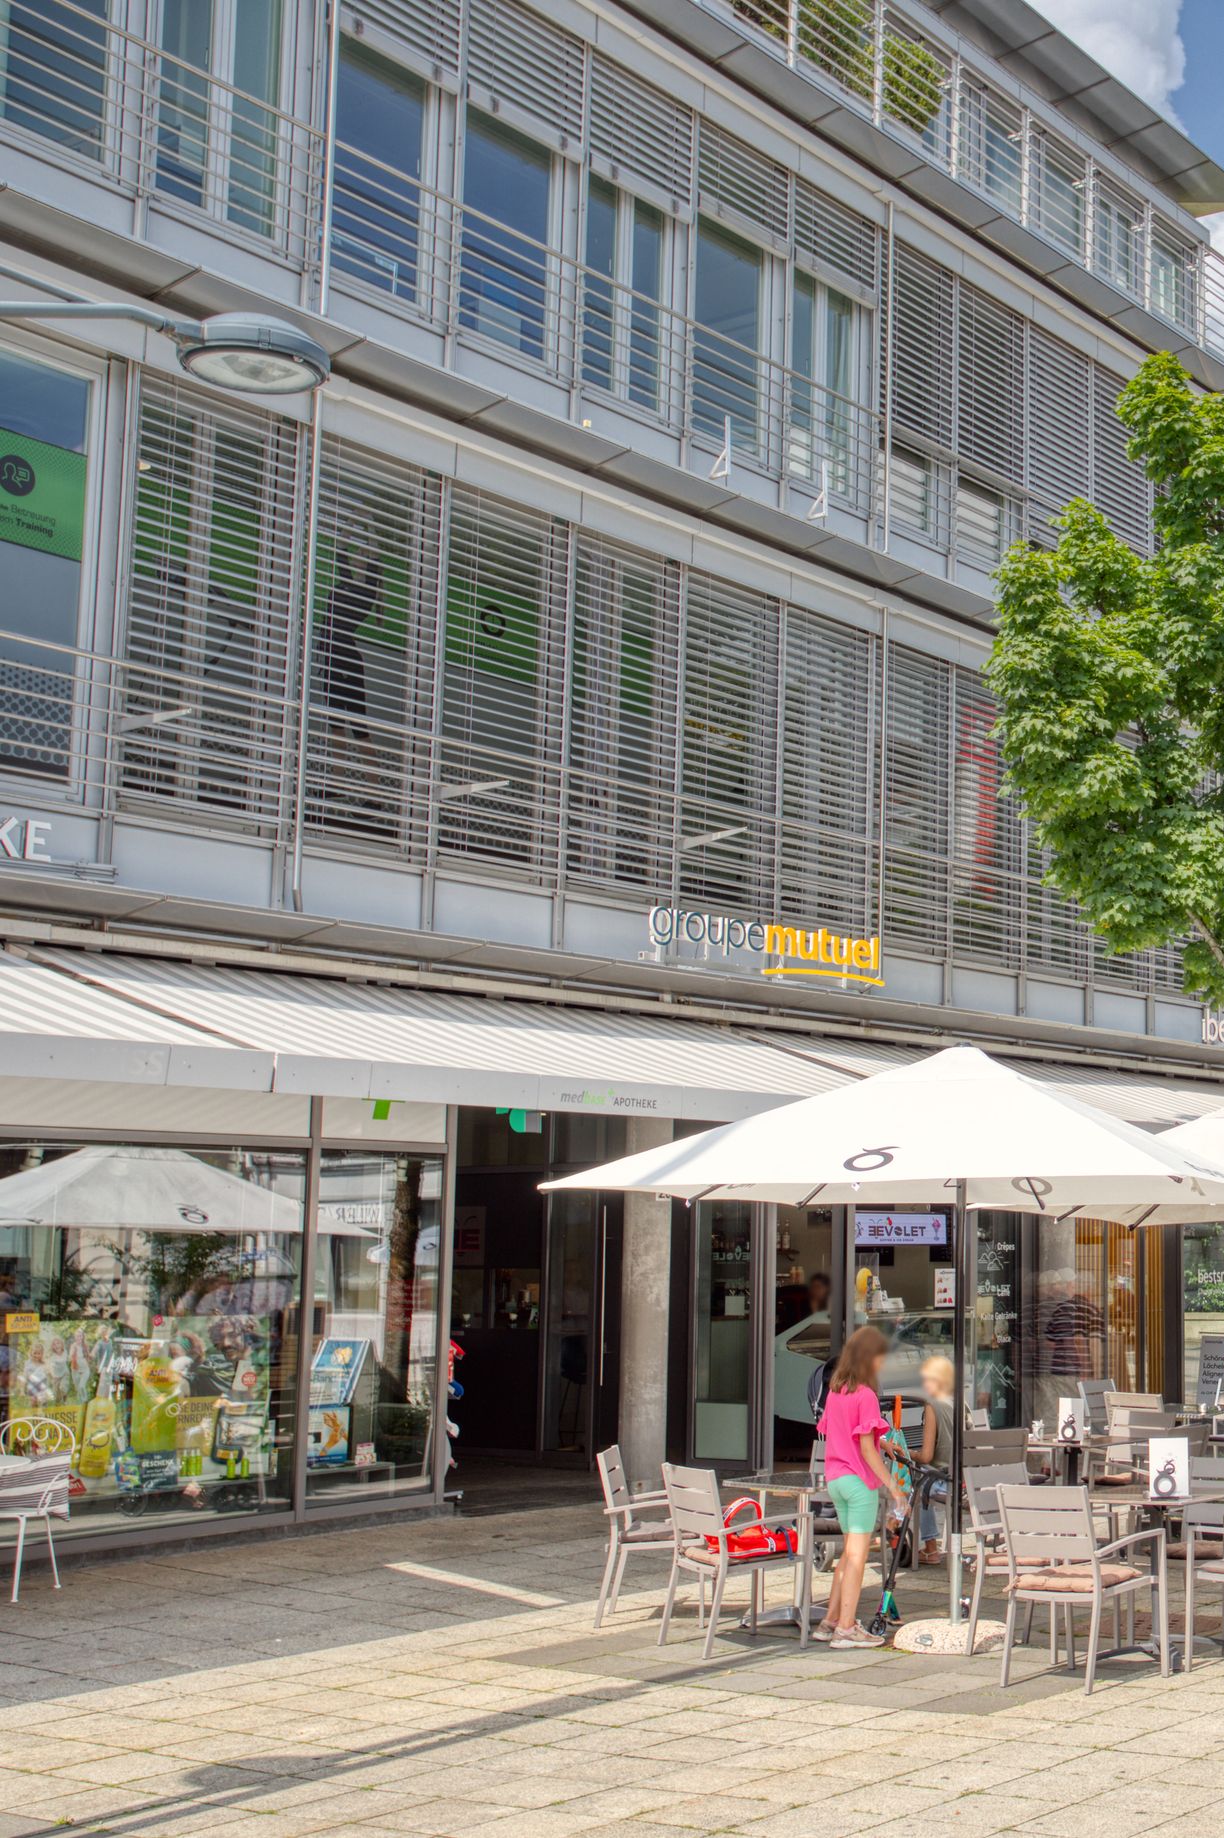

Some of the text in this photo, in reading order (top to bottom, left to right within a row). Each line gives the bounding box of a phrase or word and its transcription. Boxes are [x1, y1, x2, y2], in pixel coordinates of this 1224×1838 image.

[16, 517, 53, 538] Training
[0, 816, 52, 862] KE
[613, 1096, 657, 1109] APOTHEKE
[996, 1241, 1015, 1252] Crêpes
